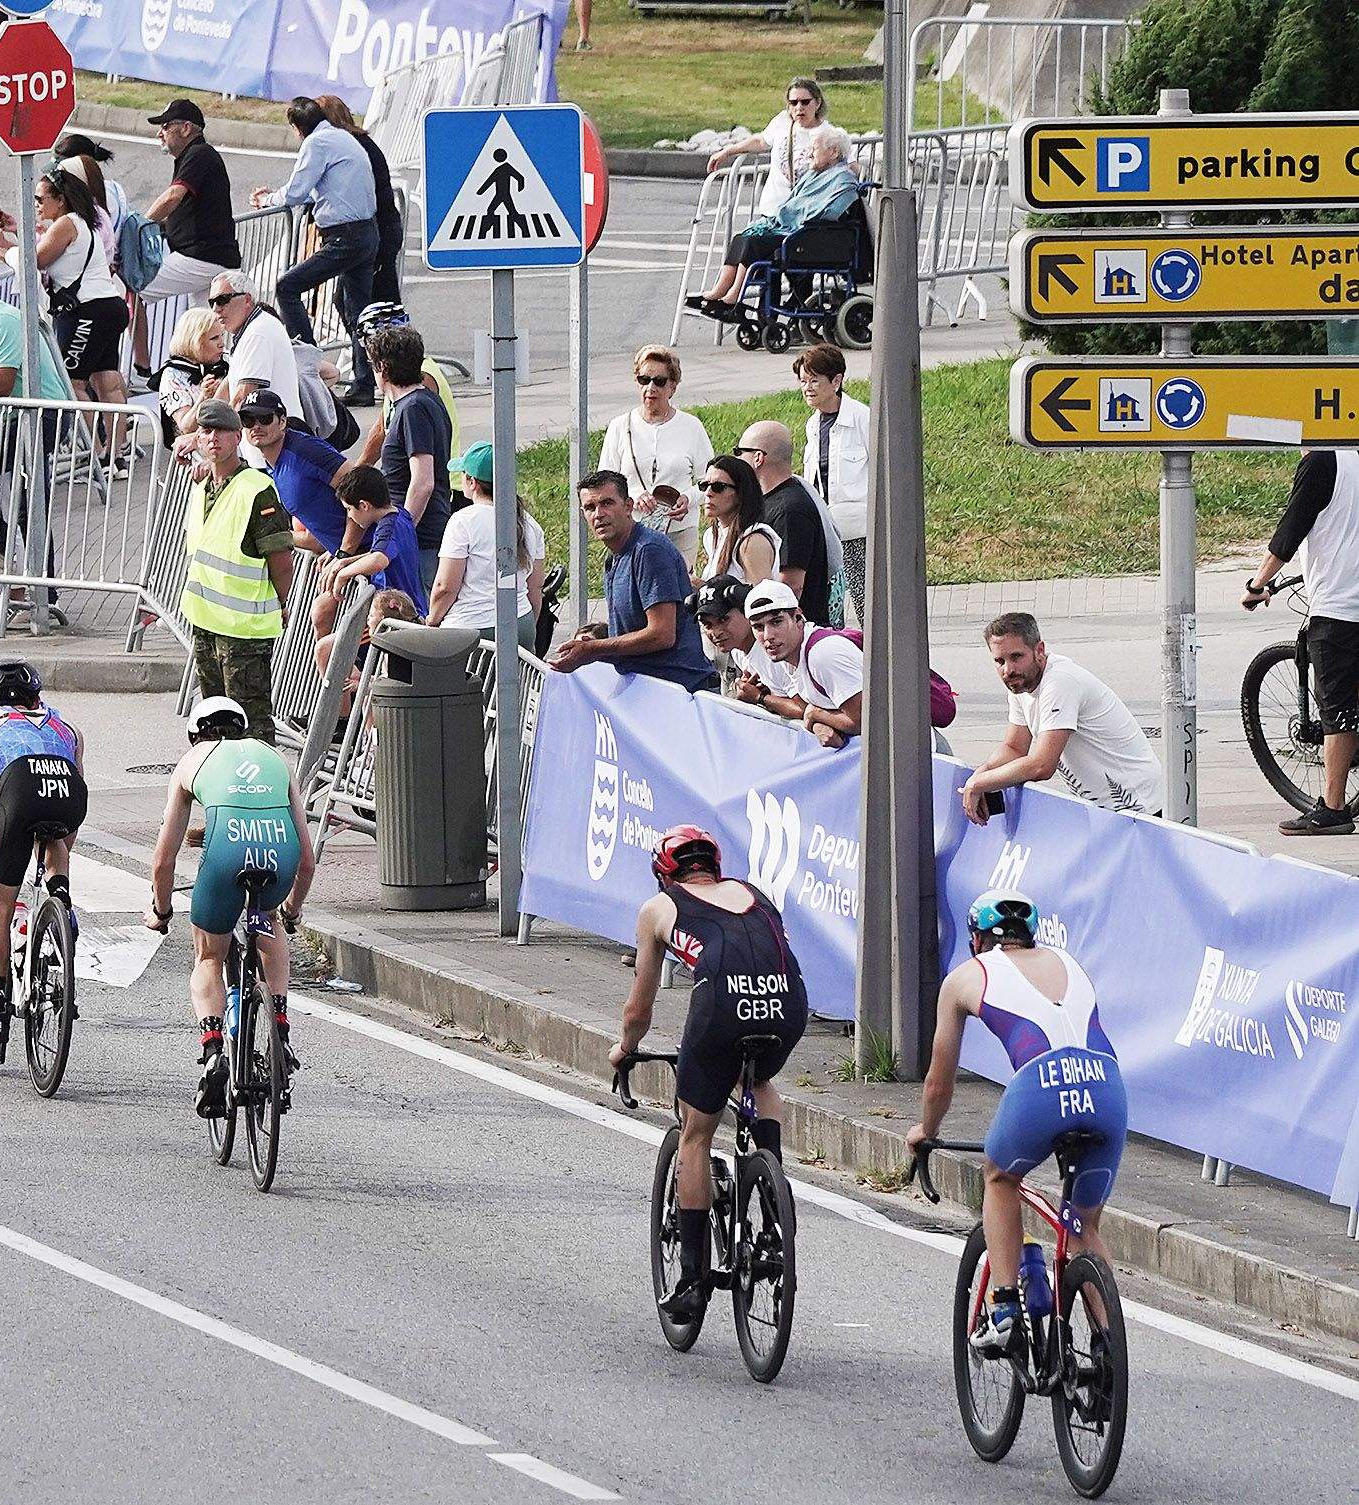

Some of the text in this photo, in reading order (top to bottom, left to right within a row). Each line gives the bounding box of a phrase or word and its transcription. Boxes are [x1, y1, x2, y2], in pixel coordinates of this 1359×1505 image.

[1177, 148, 1320, 184] parking
[1200, 244, 1274, 266] Hotel
[64, 319, 93, 370] CALVIN
[1314, 388, 1357, 420] H.
[27, 758, 72, 777] TANAKA
[37, 778, 70, 799] JPN
[227, 784, 274, 794] SCODY
[227, 818, 288, 844] SMITH
[244, 847, 279, 872] AUS
[807, 824, 860, 878] Depu
[797, 870, 860, 920] Pontev
[726, 973, 789, 996] NELSON
[1217, 961, 1261, 1006] XUNTA
[736, 998, 785, 1021] GBR
[1304, 985, 1346, 1014] DEPORTE
[1195, 1007, 1276, 1060] DE GALICIA
[1310, 1015, 1341, 1044] GALEGO
[1038, 1056, 1107, 1089] LE BIHAN
[742, 1096, 753, 1109] 14
[1058, 1088, 1096, 1118] FRA
